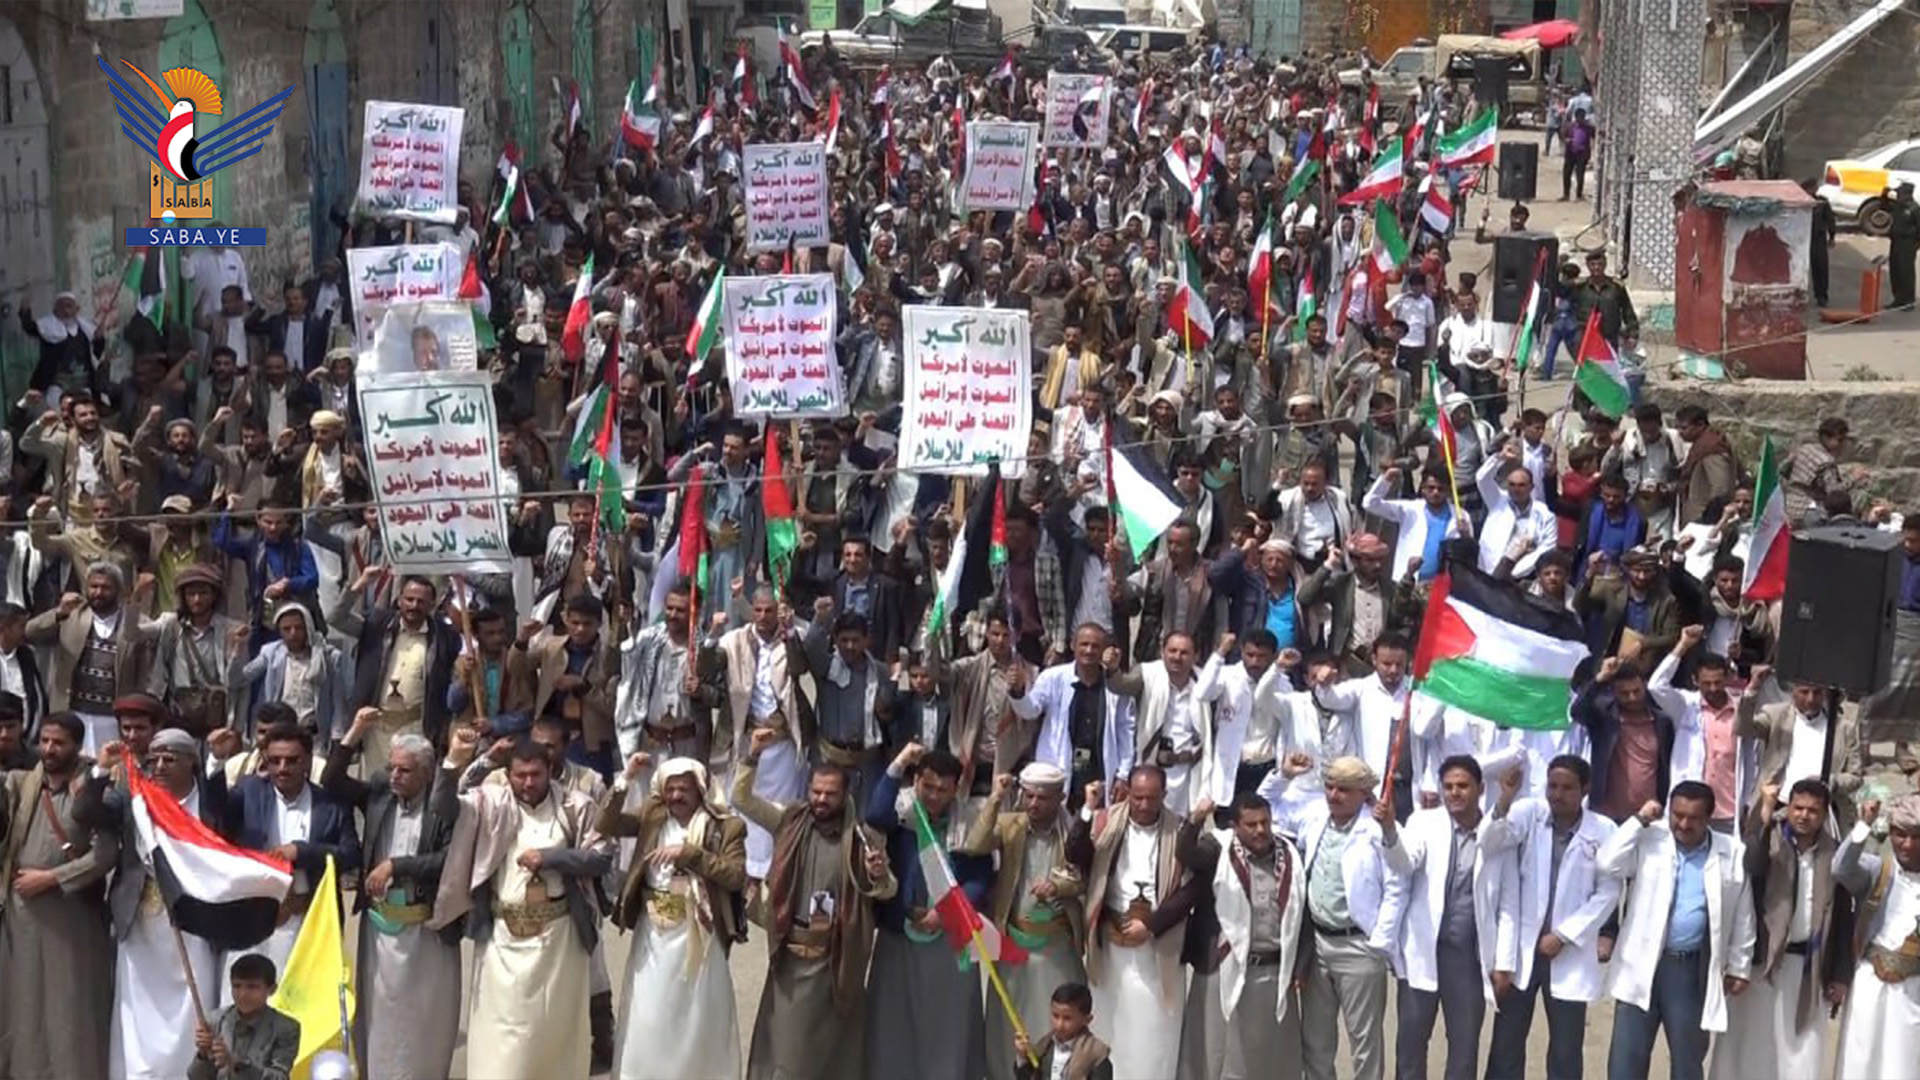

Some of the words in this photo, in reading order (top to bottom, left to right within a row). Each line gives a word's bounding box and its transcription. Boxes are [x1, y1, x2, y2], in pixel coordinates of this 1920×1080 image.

[373, 109, 418, 133] أكبر
[418, 111, 446, 132] الله
[751, 148, 791, 174] أكبر
[793, 150, 820, 166] الله
[361, 252, 409, 282] أكبر
[412, 253, 443, 273] الله
[407, 282, 443, 299] الموت
[738, 281, 792, 314] أكبر
[793, 283, 827, 306] الله
[788, 317, 828, 334] الموت
[919, 315, 977, 350] أكبر
[978, 319, 1016, 347] الله
[790, 341, 828, 358] الموت
[741, 364, 774, 383] اليهود
[778, 364, 797, 382] على
[802, 360, 830, 379] اللعنة
[919, 353, 968, 376] لأمريكا
[972, 359, 1017, 379] الموت
[795, 386, 834, 412] النصر
[971, 386, 1016, 406] الموت
[372, 391, 452, 438] أكبر
[450, 393, 486, 425] الله
[917, 410, 953, 431] اليهود
[955, 412, 977, 432] على
[981, 412, 1015, 431] اللعنة
[374, 436, 435, 463] لأمريكا
[439, 437, 488, 459] الموت
[446, 471, 491, 492] الموت
[388, 502, 433, 526] اليهود
[436, 500, 462, 524] على
[393, 529, 457, 558] للإسلام
[464, 529, 500, 556] النصر
